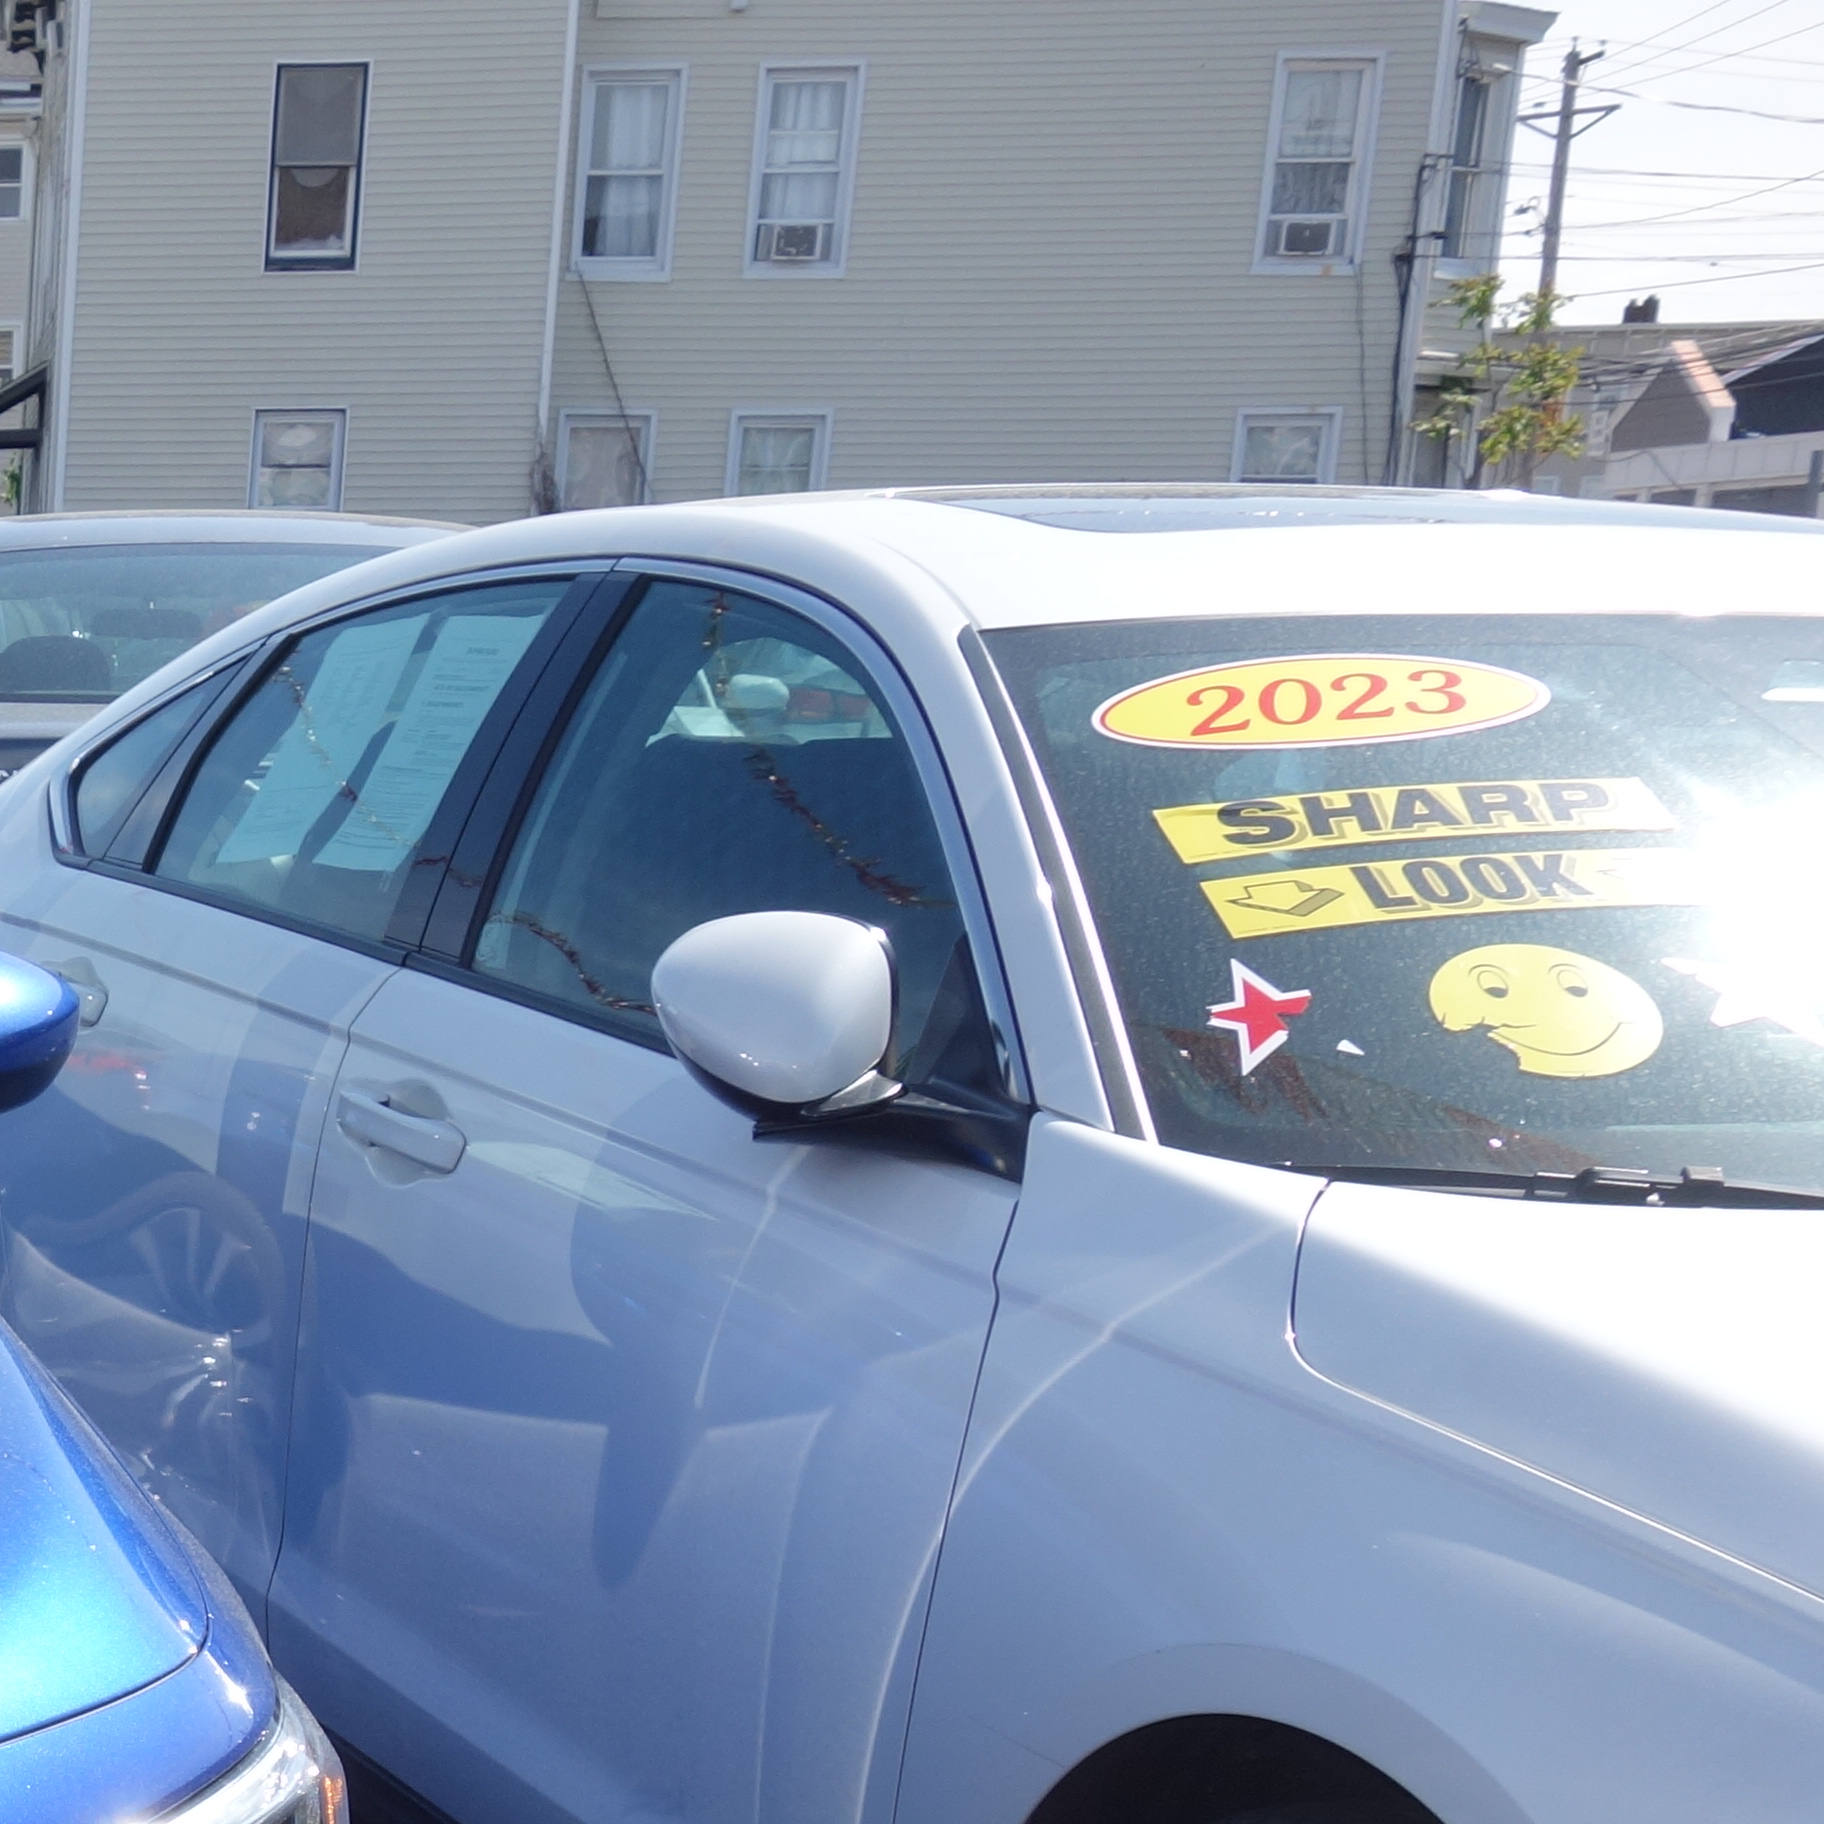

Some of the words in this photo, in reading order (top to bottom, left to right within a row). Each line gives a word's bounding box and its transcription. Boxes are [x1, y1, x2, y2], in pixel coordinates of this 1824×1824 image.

[1185, 669, 1467, 737] 2023
[1215, 781, 1610, 847] SHARP
[1350, 852, 1594, 911] LOOK
